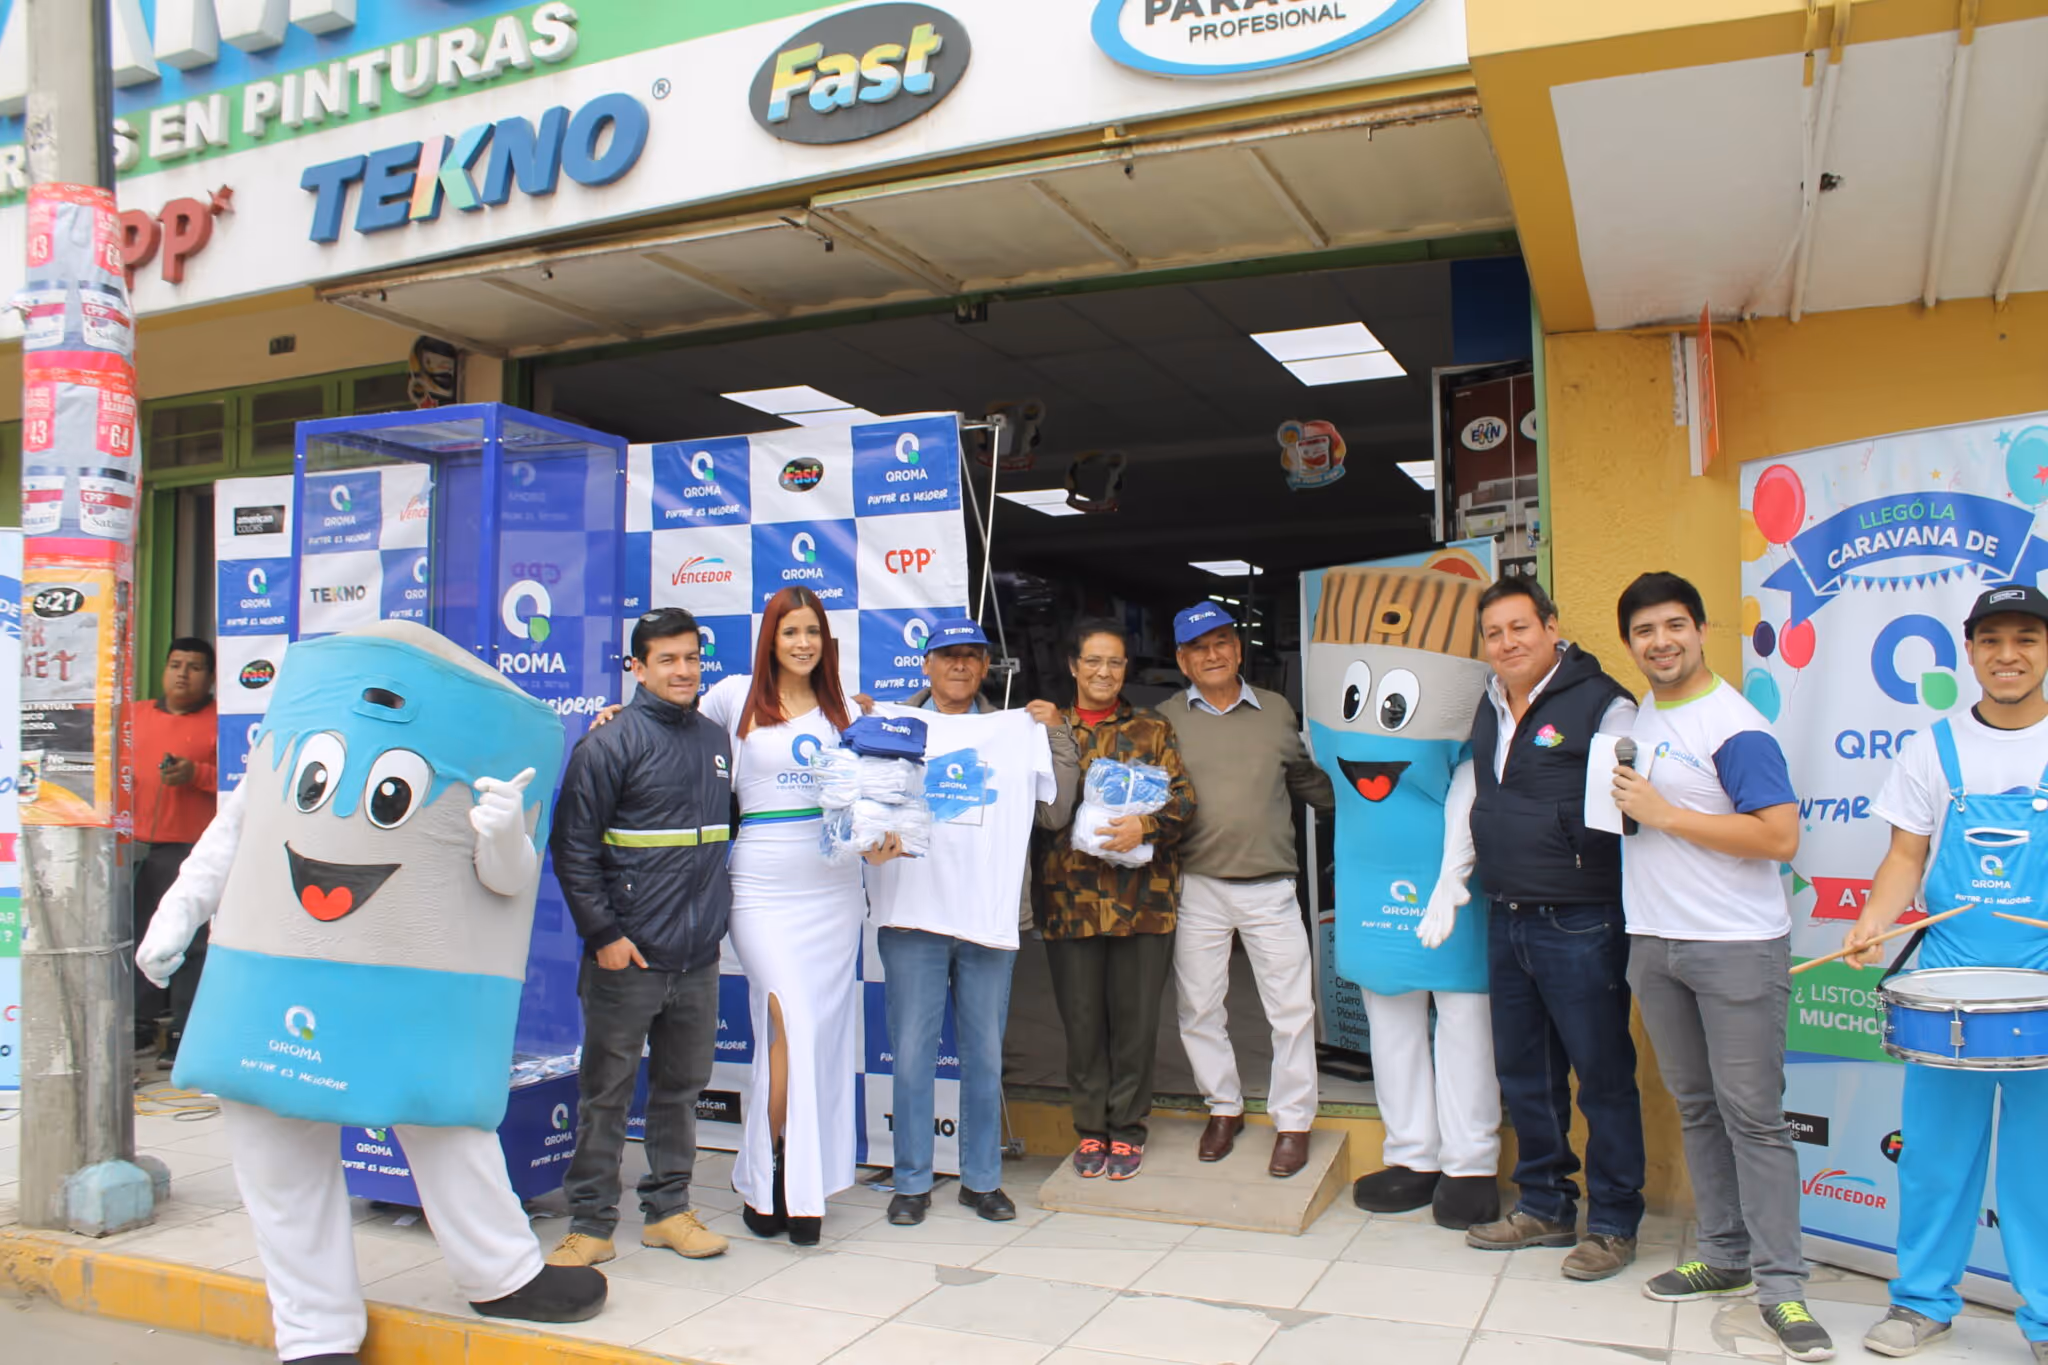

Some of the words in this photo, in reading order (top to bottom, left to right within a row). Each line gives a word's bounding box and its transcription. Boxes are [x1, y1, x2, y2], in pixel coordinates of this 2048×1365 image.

[1188, 5, 1347, 43] PROFESIONAL
[149, 93, 231, 163] EN
[243, 1, 579, 138] PINTURAS
[766, 23, 943, 123] Fast
[300, 92, 650, 245] TEKNO
[110, 424, 130, 451] 64
[784, 465, 819, 485] Fast
[886, 468, 929, 483] QROMA
[683, 485, 722, 499] QROMA
[1858, 499, 1925, 530] LLEGÓ
[1930, 503, 1956, 520] LA
[1827, 526, 1958, 570] CARAVANA
[1965, 531, 1999, 558] DE
[885, 548, 931, 575] CPP
[671, 565, 733, 586] VENCEDOR
[782, 568, 824, 581] QROMA
[310, 585, 366, 603] TEKNO
[1971, 879, 2012, 890] QROMA
[1811, 984, 1878, 1009] LISTOS
[268, 1039, 323, 1064] QROMA
[356, 1142, 393, 1157] QROMA
[544, 1131, 573, 1147] QROMA
[1801, 1174, 1887, 1210] VENCEDOR
